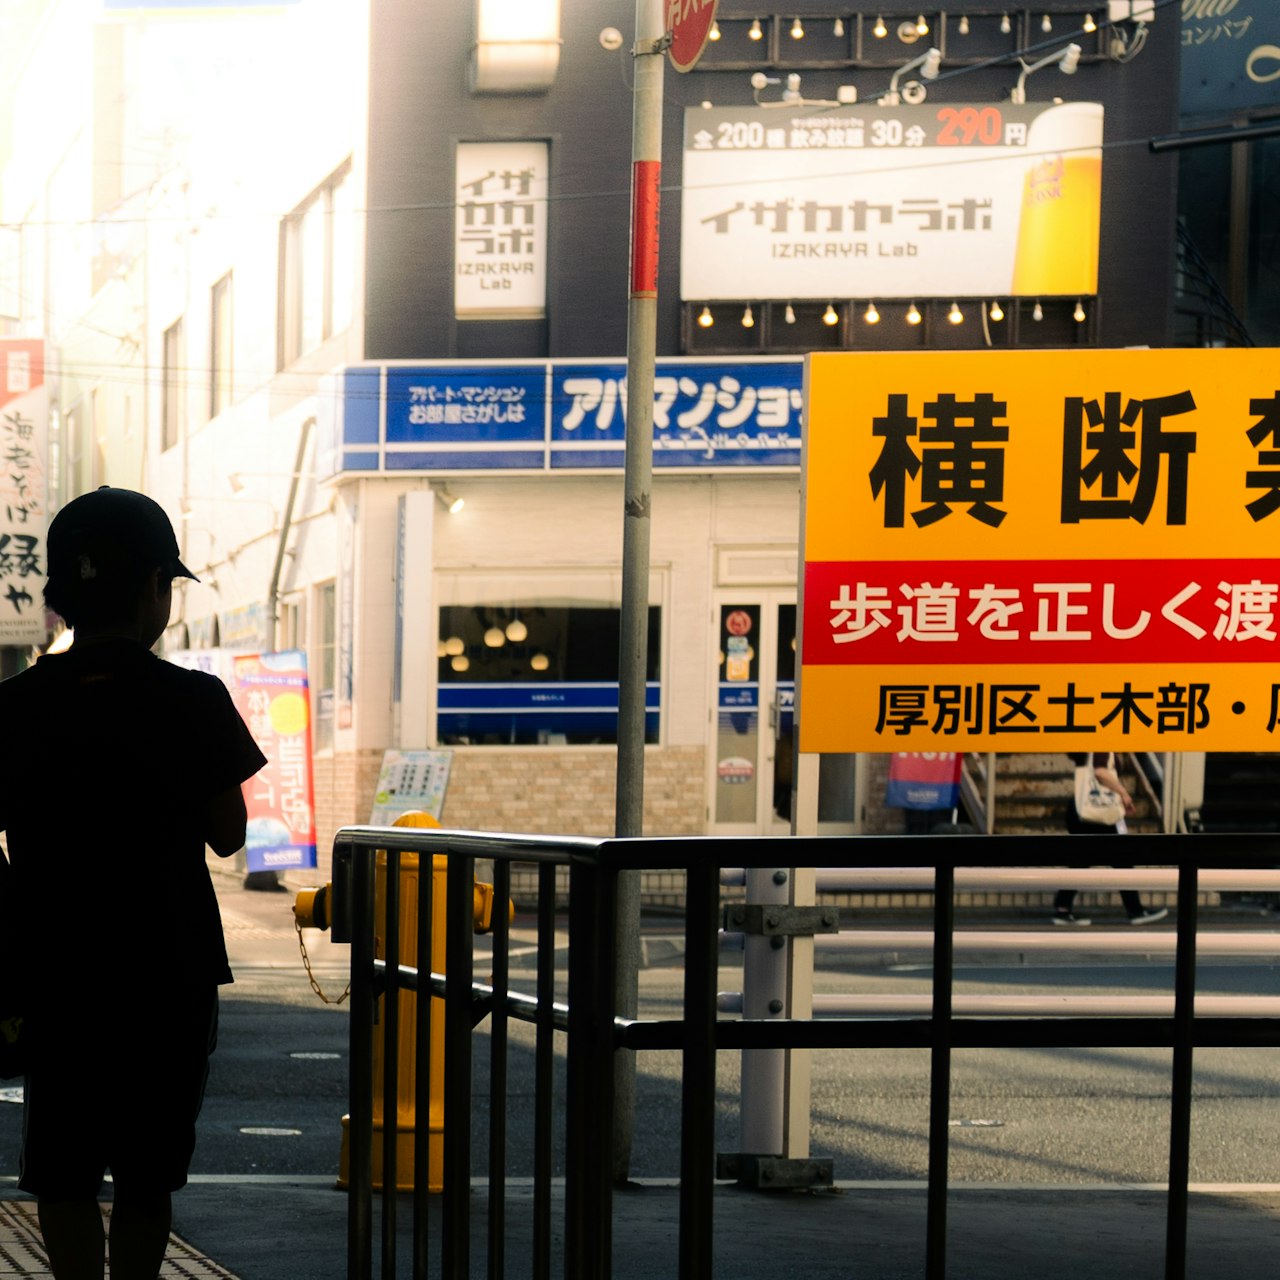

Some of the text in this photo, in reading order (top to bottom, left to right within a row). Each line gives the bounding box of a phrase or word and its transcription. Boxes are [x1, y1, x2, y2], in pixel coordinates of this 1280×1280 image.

[935, 107, 1026, 146] 290円
[700, 197, 993, 233] イザカヤラボ
[460, 229, 534, 254] ラボ
[772, 240, 919, 260] IZAKAYA Lab
[459, 262, 535, 275] IZAKAYA
[480, 277, 512, 289] Lab
[409, 404, 526, 425] お部屋さがしは
[868, 390, 1280, 529] 横断
[875, 682, 1280, 736] 厚別区土木部・
